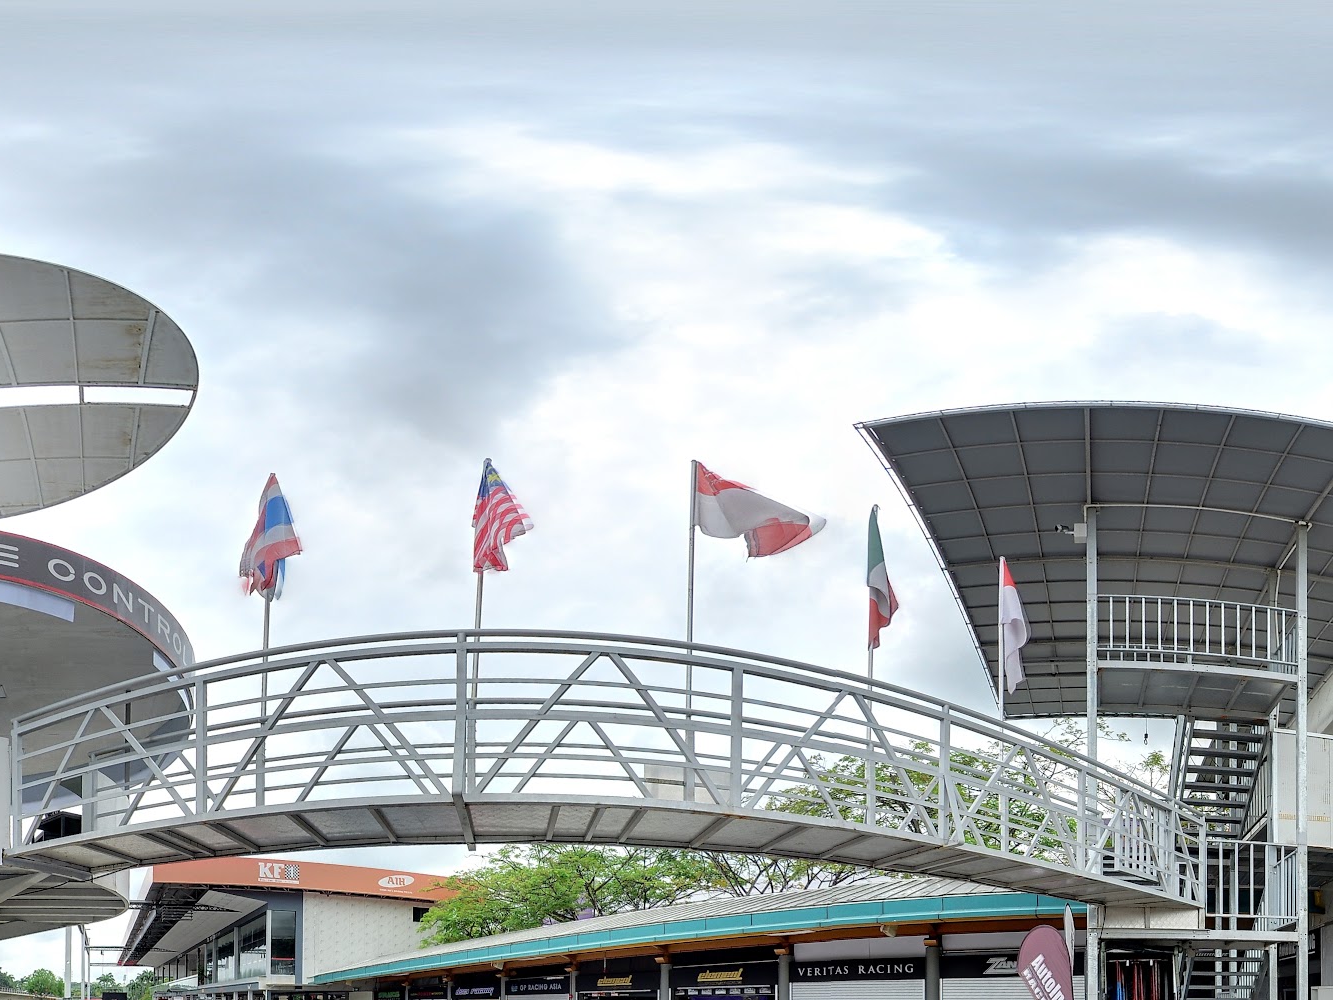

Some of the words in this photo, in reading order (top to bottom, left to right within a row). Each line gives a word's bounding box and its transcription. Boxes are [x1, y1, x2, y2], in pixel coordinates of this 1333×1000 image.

[47, 558, 190, 666] CONTROL
[797, 965, 849, 976] VERITAS
[857, 963, 914, 975] RACING
[982, 957, 1018, 975] ZAN
